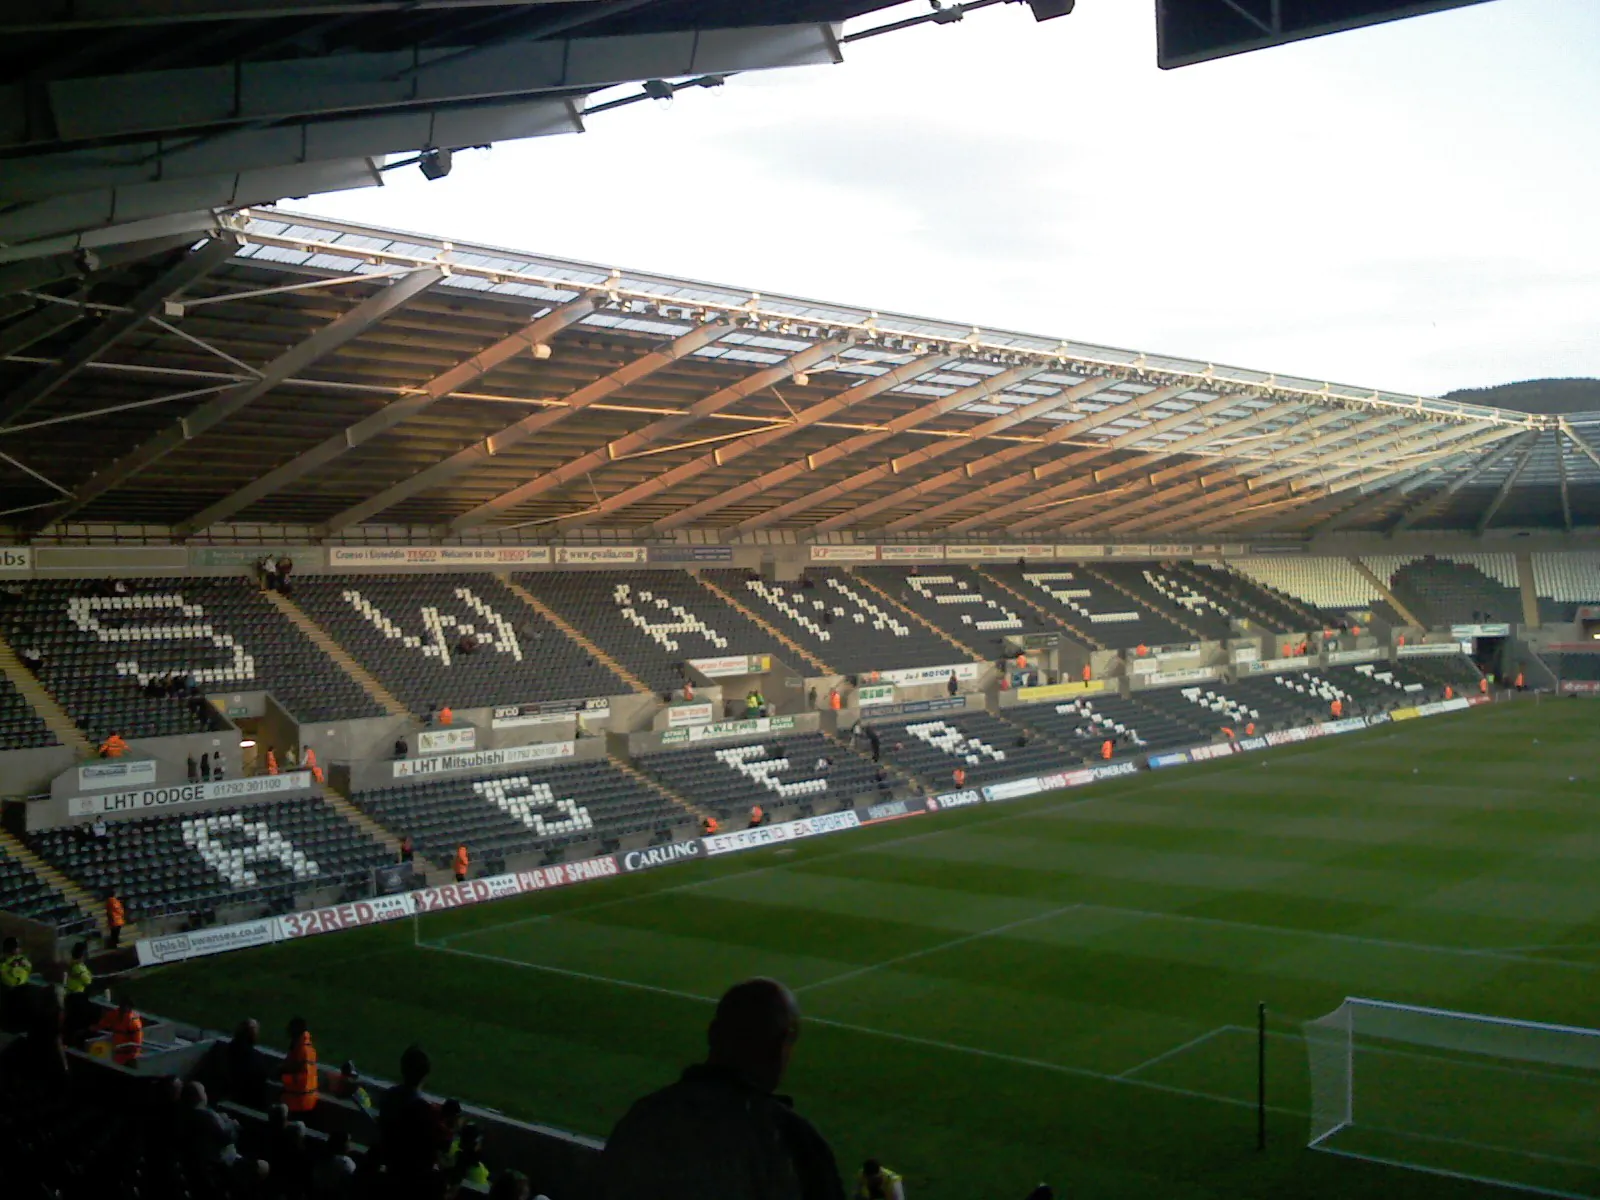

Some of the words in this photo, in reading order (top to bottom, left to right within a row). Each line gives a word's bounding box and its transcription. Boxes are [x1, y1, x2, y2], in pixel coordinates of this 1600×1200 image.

[0, 551, 26, 566] bs
[412, 758, 438, 774] LHT
[442, 749, 505, 771] Mitsubishi
[103, 793, 138, 811] LHT
[142, 784, 205, 806] DODGE
[213, 781, 245, 797] 01792
[544, 864, 565, 886] UP
[565, 856, 617, 882] SPARES
[624, 841, 699, 871] CARLING
